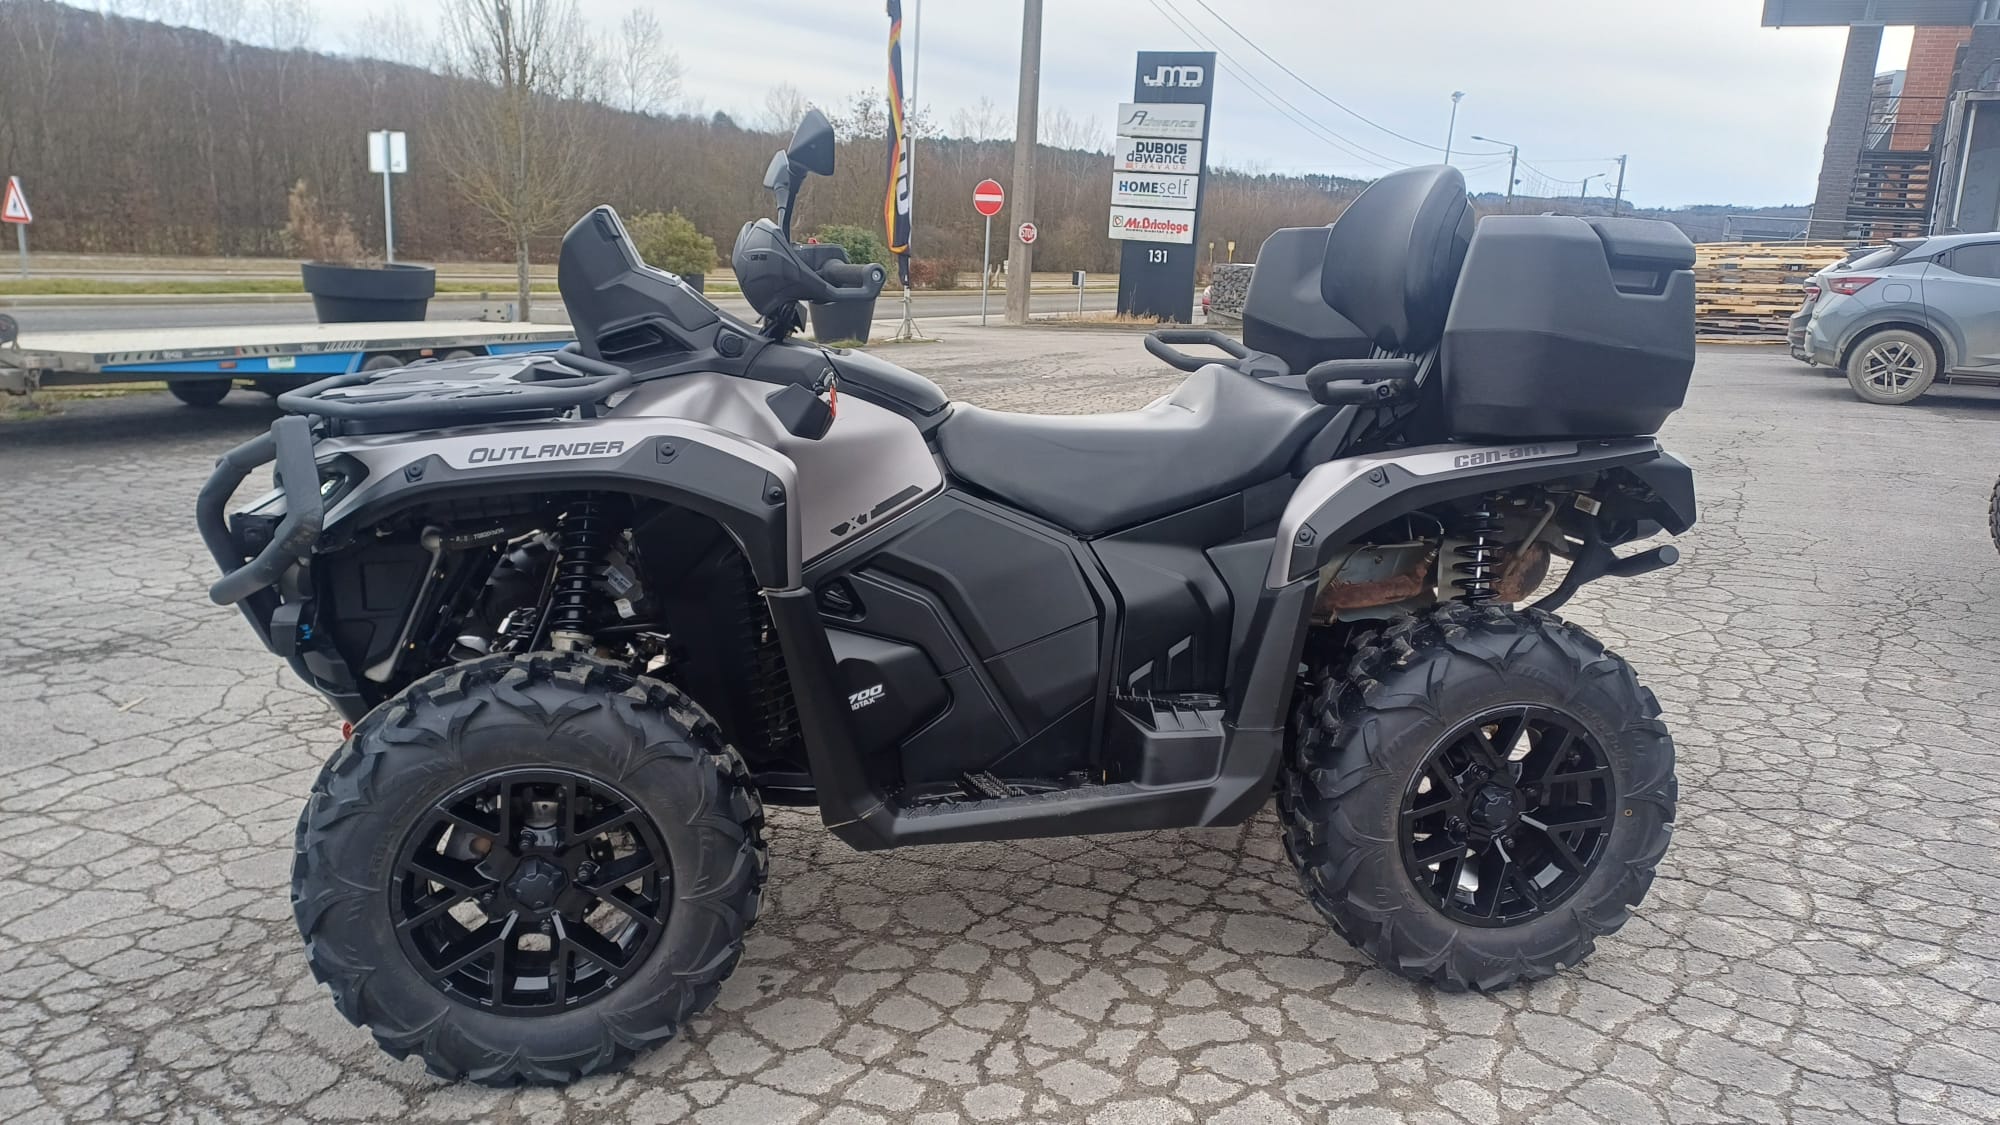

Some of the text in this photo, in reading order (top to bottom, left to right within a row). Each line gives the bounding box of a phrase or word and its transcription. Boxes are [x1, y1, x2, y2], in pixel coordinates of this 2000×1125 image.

[1136, 142, 1187, 154] DUBOIS
[1126, 150, 1187, 164] dawance
[1119, 179, 1190, 195] HOMEself
[1020, 228, 1035, 239] STOP
[1148, 249, 1168, 263] 131
[468, 441, 625, 464] OUTLANDER
[848, 684, 883, 705] 700
